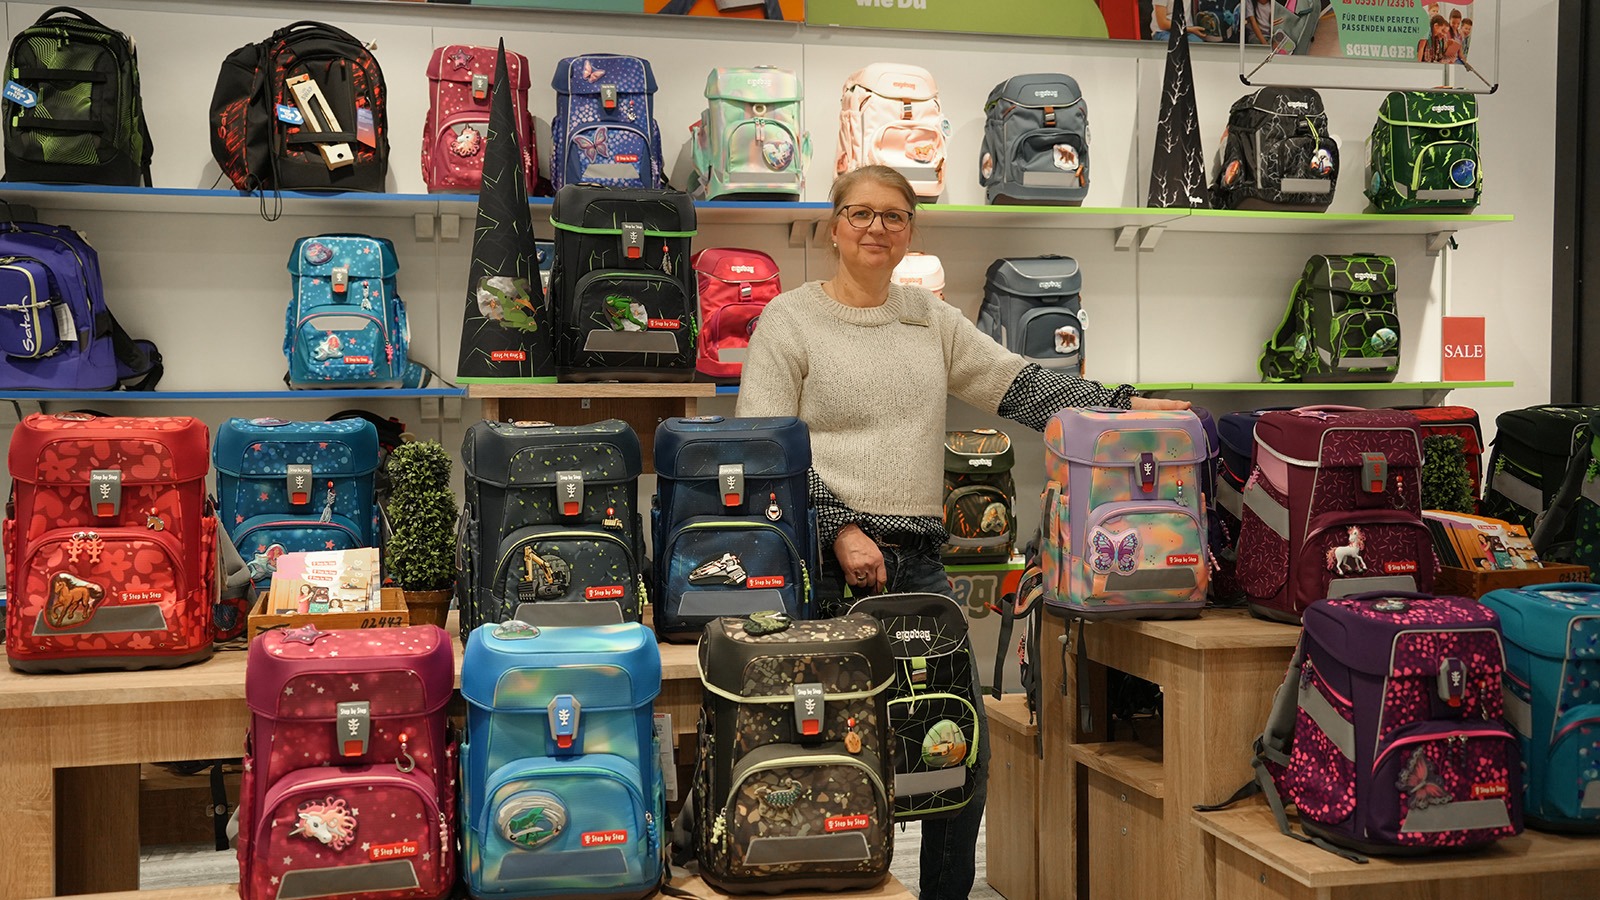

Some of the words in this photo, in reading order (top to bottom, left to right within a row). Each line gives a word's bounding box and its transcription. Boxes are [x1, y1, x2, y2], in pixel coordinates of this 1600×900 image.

[1342, 12, 1356, 21] FÜR
[1358, 14, 1385, 23] DEINEN
[1386, 16, 1419, 24] PERFEKT
[1341, 23, 1385, 32] PASSENDEN
[1387, 26, 1420, 34] RANZEN!
[1346, 43, 1416, 59] SCHWAGER
[1444, 344, 1484, 358] SALE
[129, 592, 141, 600] Step
[142, 592, 149, 600] by
[150, 591, 161, 599] Step
[895, 629, 931, 641] ergobag
[356, 707, 367, 715] Step
[834, 820, 846, 828] Step
[847, 819, 854, 827] by
[854, 818, 866, 826] Step
[604, 834, 611, 842] by
[612, 833, 624, 841] Step
[381, 848, 393, 856] Step
[402, 845, 415, 854] Step
